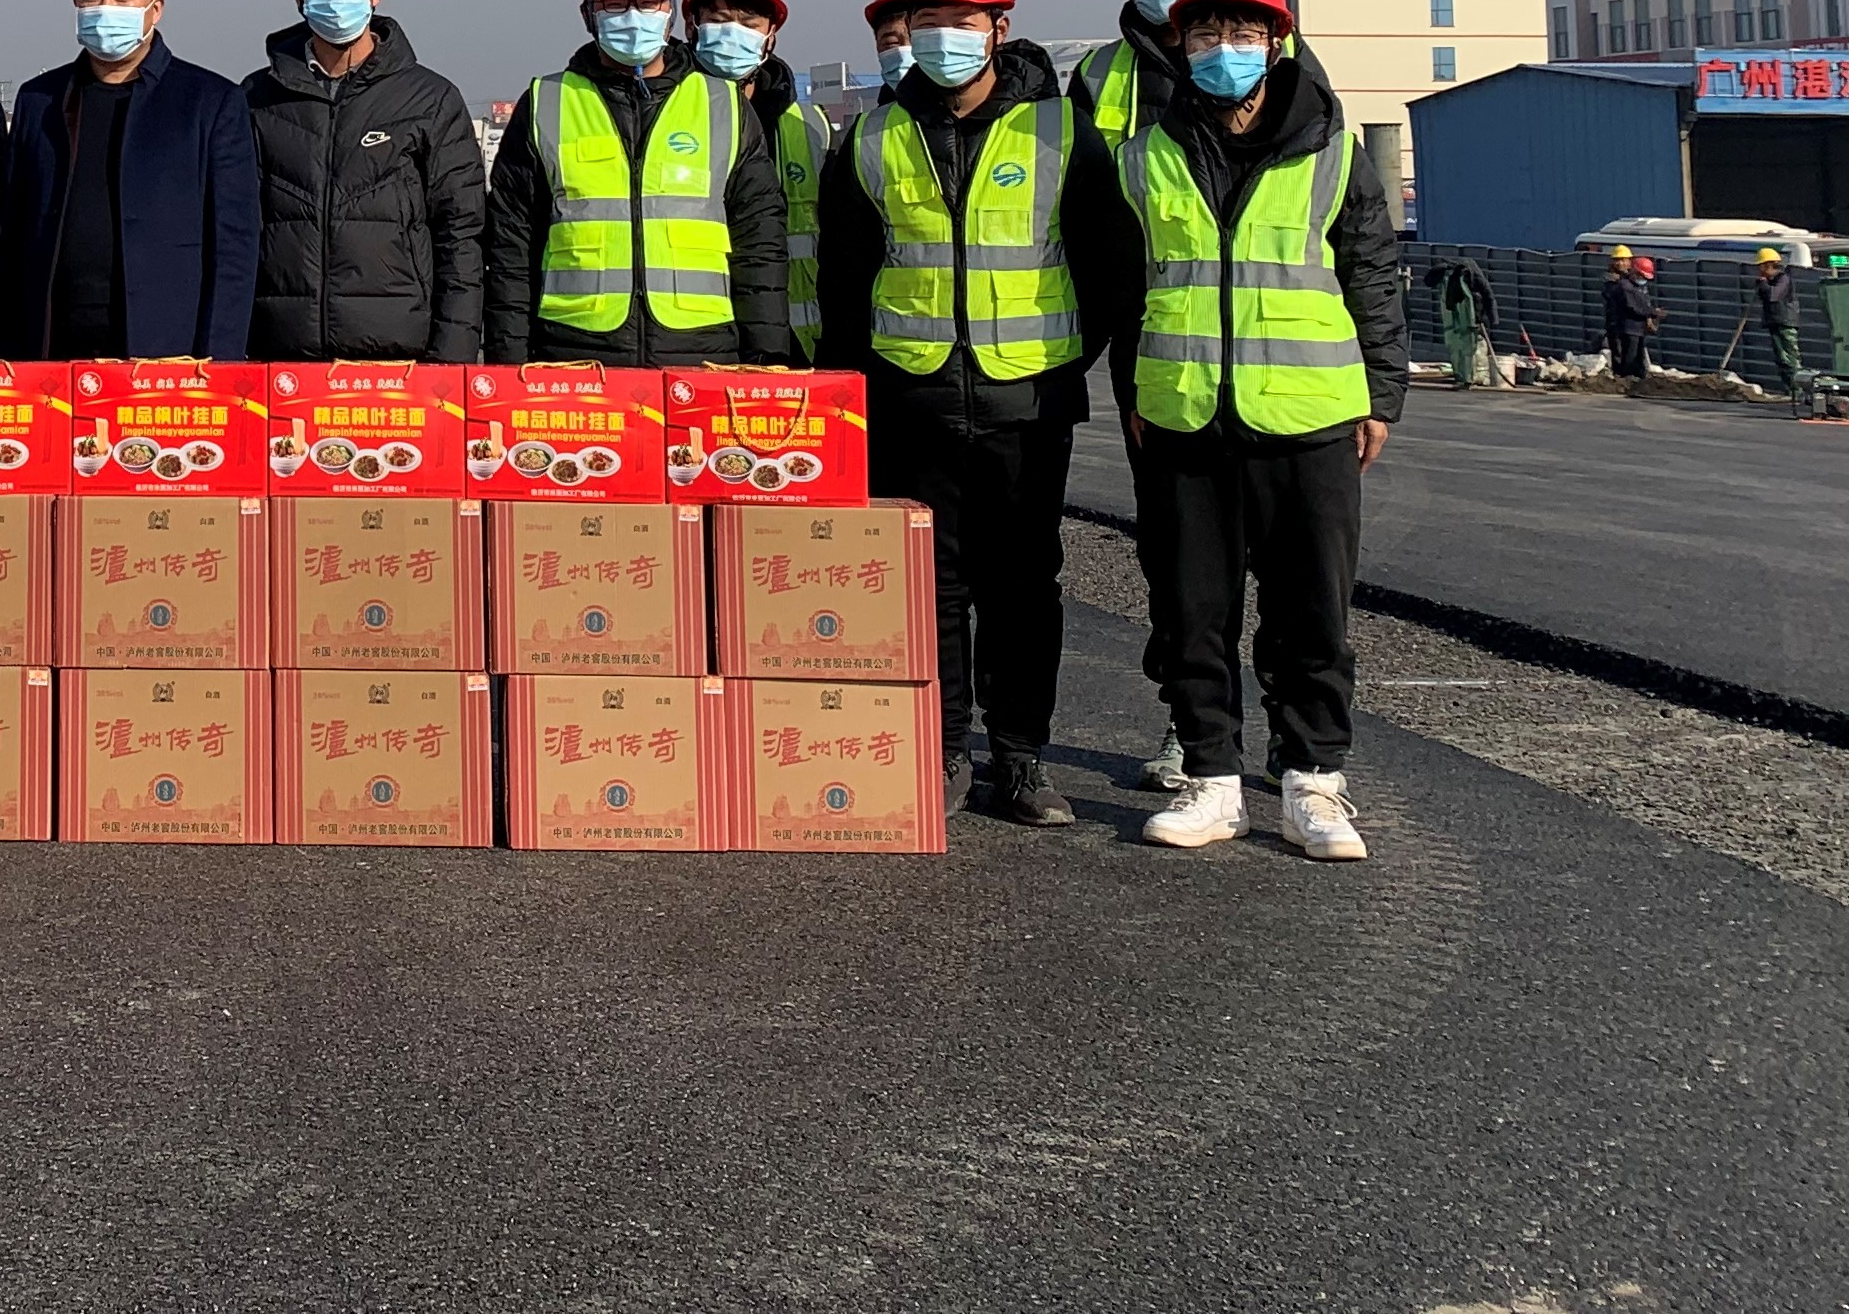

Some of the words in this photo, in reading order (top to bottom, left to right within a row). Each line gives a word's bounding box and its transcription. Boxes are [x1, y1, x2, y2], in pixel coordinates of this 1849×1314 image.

[1697, 58, 1849, 99] 广州湛
[117, 405, 228, 425] 精品枫叶挂面
[313, 406, 426, 427] 精品枫叶挂面
[511, 409, 625, 432] 精品枫叶挂面
[711, 415, 826, 436] 精品枫叶挂面
[200, 517, 215, 525] 白酒
[633, 524, 649, 532] 白酒
[874, 697, 890, 707] 白酒
